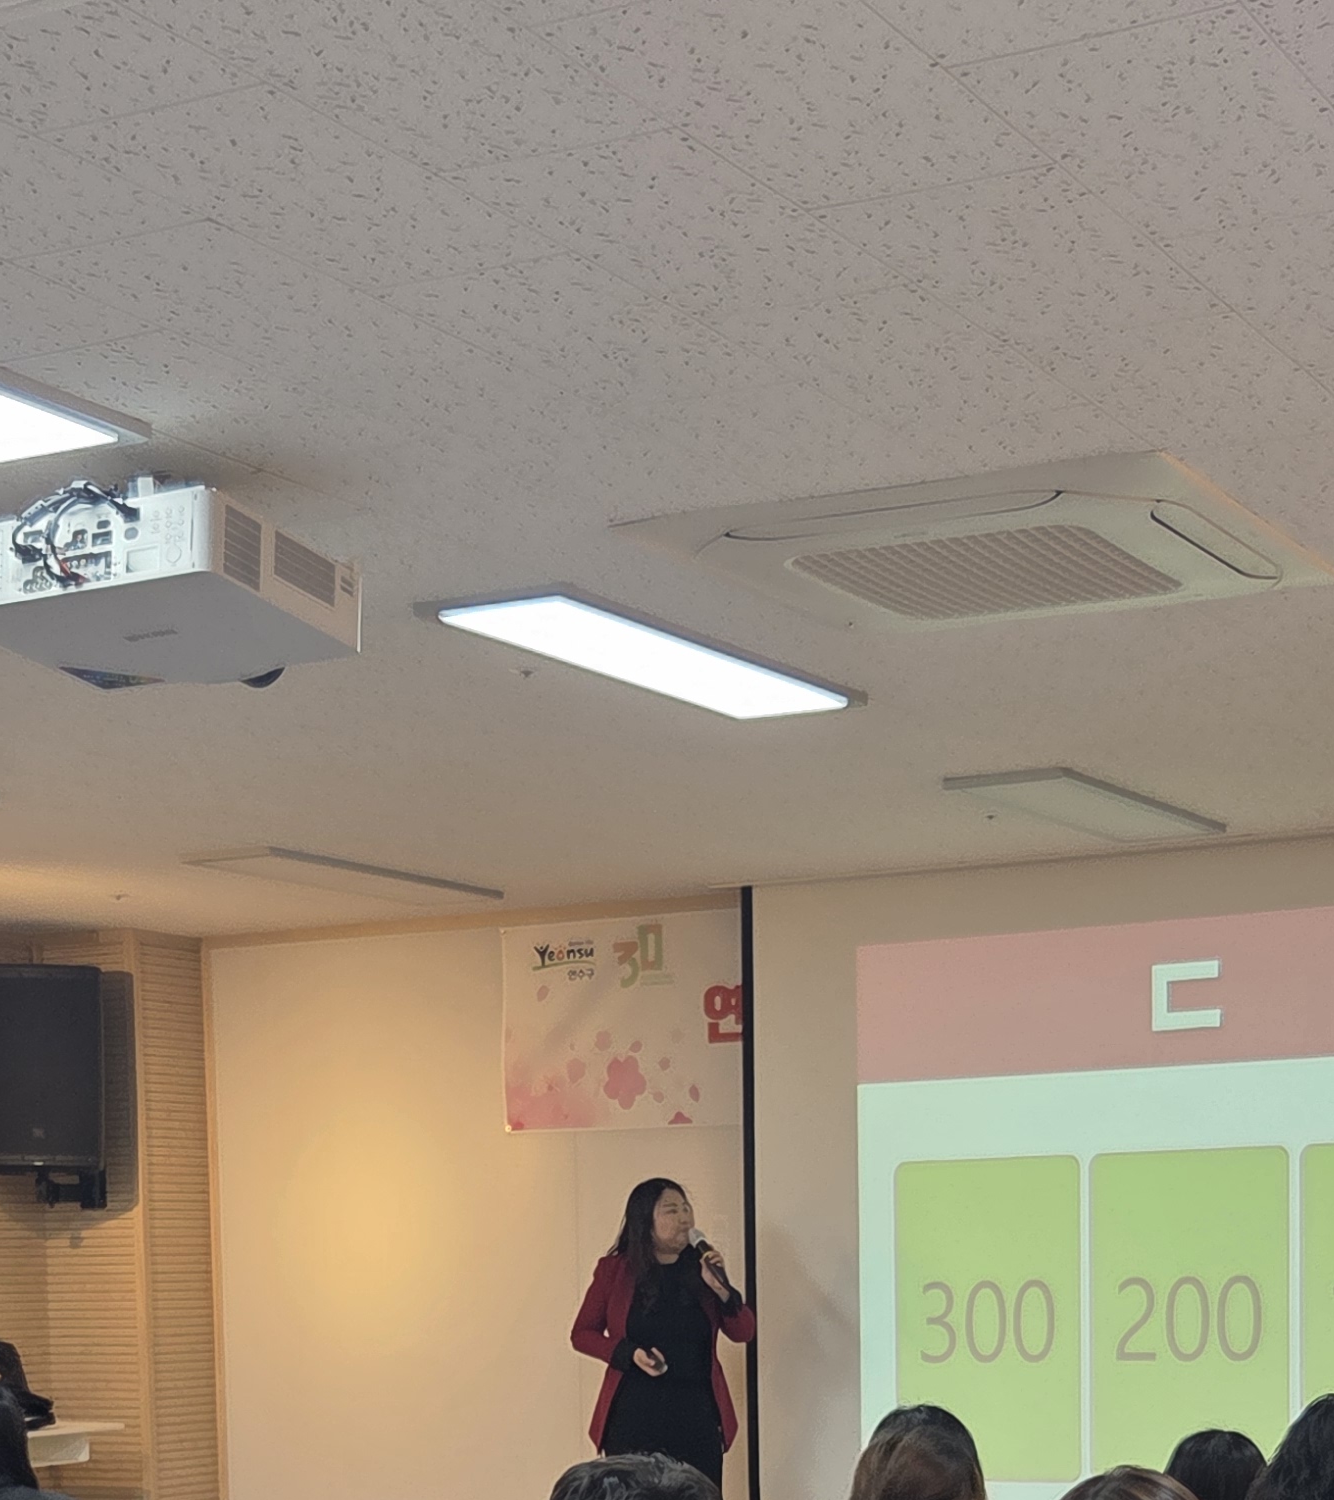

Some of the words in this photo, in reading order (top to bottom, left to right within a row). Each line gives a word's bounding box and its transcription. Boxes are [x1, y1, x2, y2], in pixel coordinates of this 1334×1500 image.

[533, 944, 595, 967] Yeonsu
[567, 968, 595, 981] 연수구
[918, 1279, 1057, 1364] 300
[1115, 1274, 1263, 1362] 200
